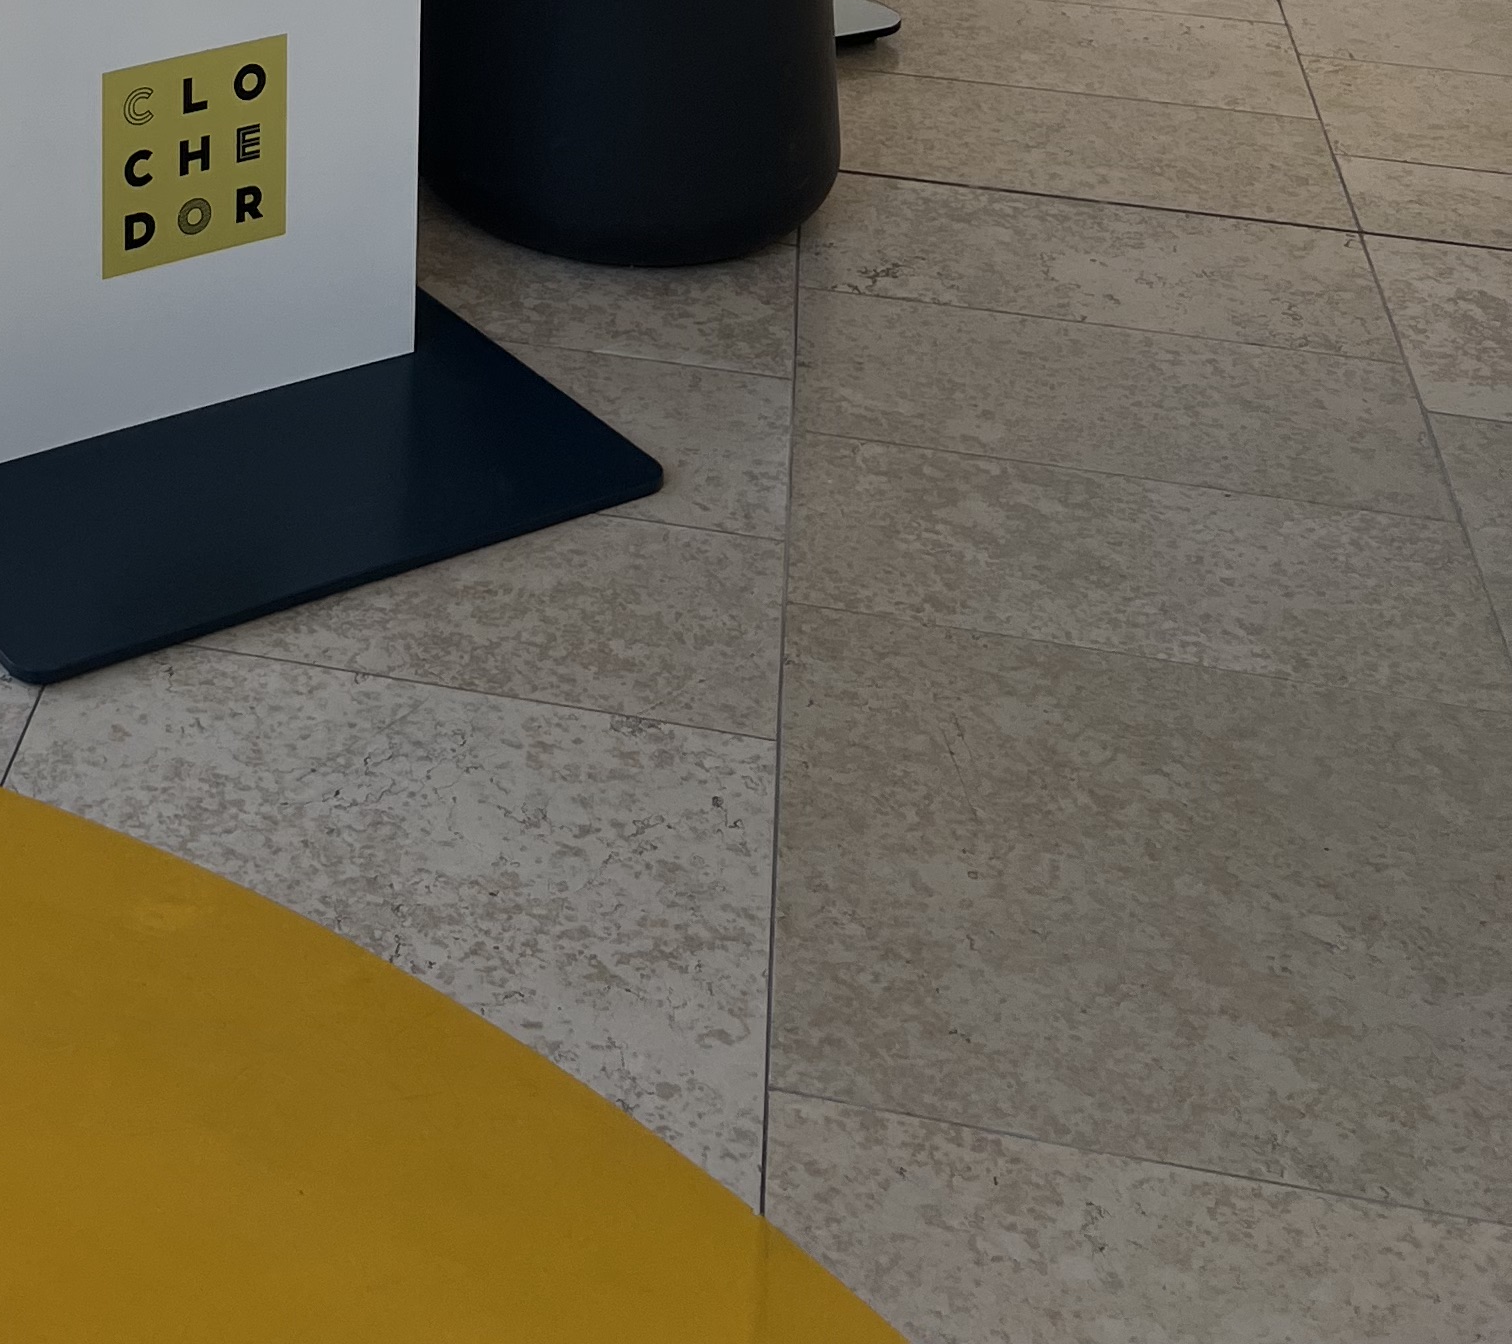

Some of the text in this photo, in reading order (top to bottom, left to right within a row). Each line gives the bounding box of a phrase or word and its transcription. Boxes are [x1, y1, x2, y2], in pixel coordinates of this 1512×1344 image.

[123, 63, 267, 126] CLO
[123, 122, 261, 188] CHE
[124, 185, 264, 251] DOR
